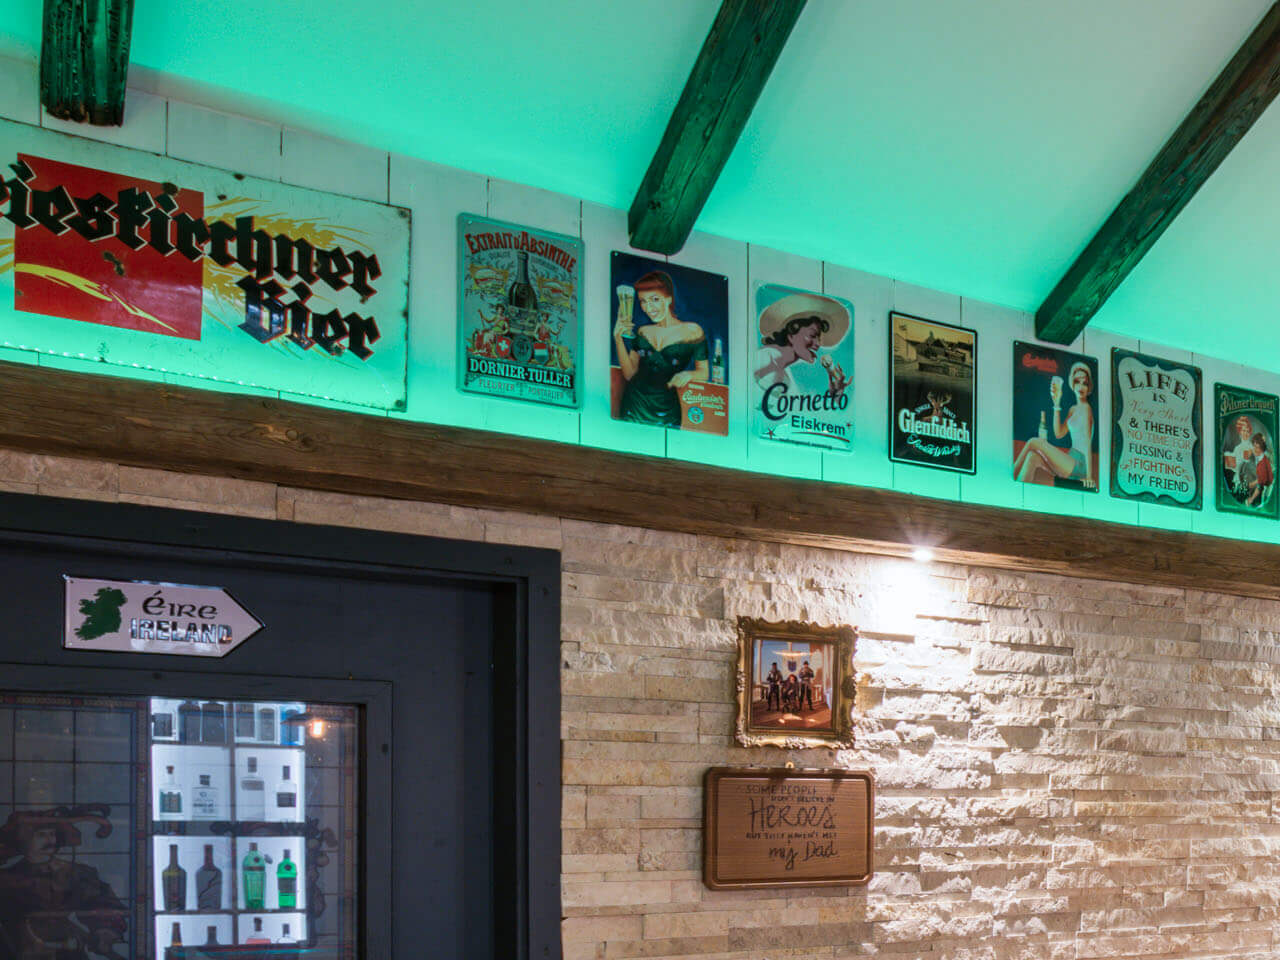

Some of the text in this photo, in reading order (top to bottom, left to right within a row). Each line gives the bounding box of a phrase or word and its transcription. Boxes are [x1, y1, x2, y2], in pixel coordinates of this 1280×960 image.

[465, 231, 514, 253] EXTRAIT
[236, 275, 381, 361] Bier
[1126, 370, 1190, 402] LIFE
[761, 382, 849, 421] Cornetto
[1153, 392, 1166, 403] IS
[791, 414, 847, 436] Eiskrem
[898, 408, 970, 444] Glenfiddich
[1129, 417, 1190, 439] & THERE'S
[1129, 443, 1184, 462] FUSSING &
[1134, 458, 1182, 477] FIGHTING
[1128, 472, 1190, 493] MY FRIEND
[130, 617, 233, 645] IRELAND
[802, 840, 838, 861] Dad
